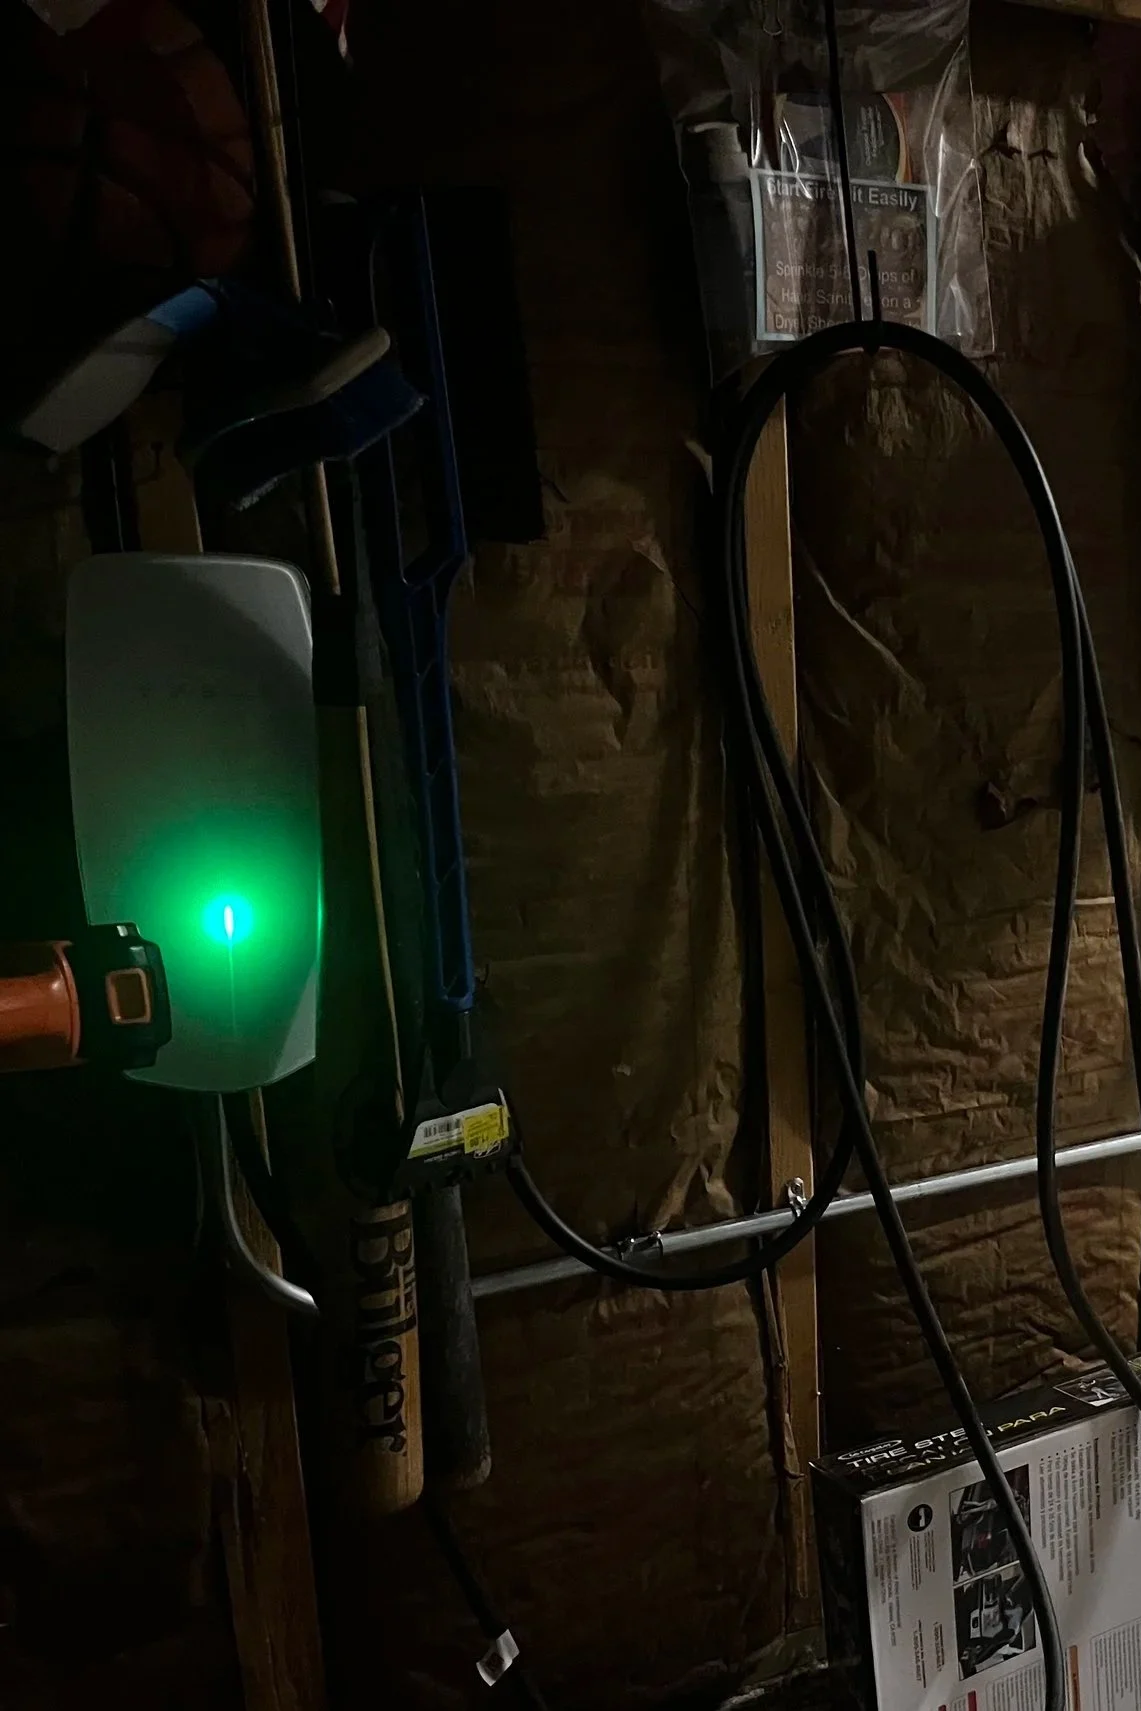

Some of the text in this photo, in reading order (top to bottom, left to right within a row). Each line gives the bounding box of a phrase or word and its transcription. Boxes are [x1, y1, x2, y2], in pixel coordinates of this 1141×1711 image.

[868, 187, 919, 212] Easily
[901, 269, 916, 283] of
[996, 1406, 1068, 1432] PARA
[845, 1446, 908, 1469] TIRE
[914, 1427, 967, 1450] STE
